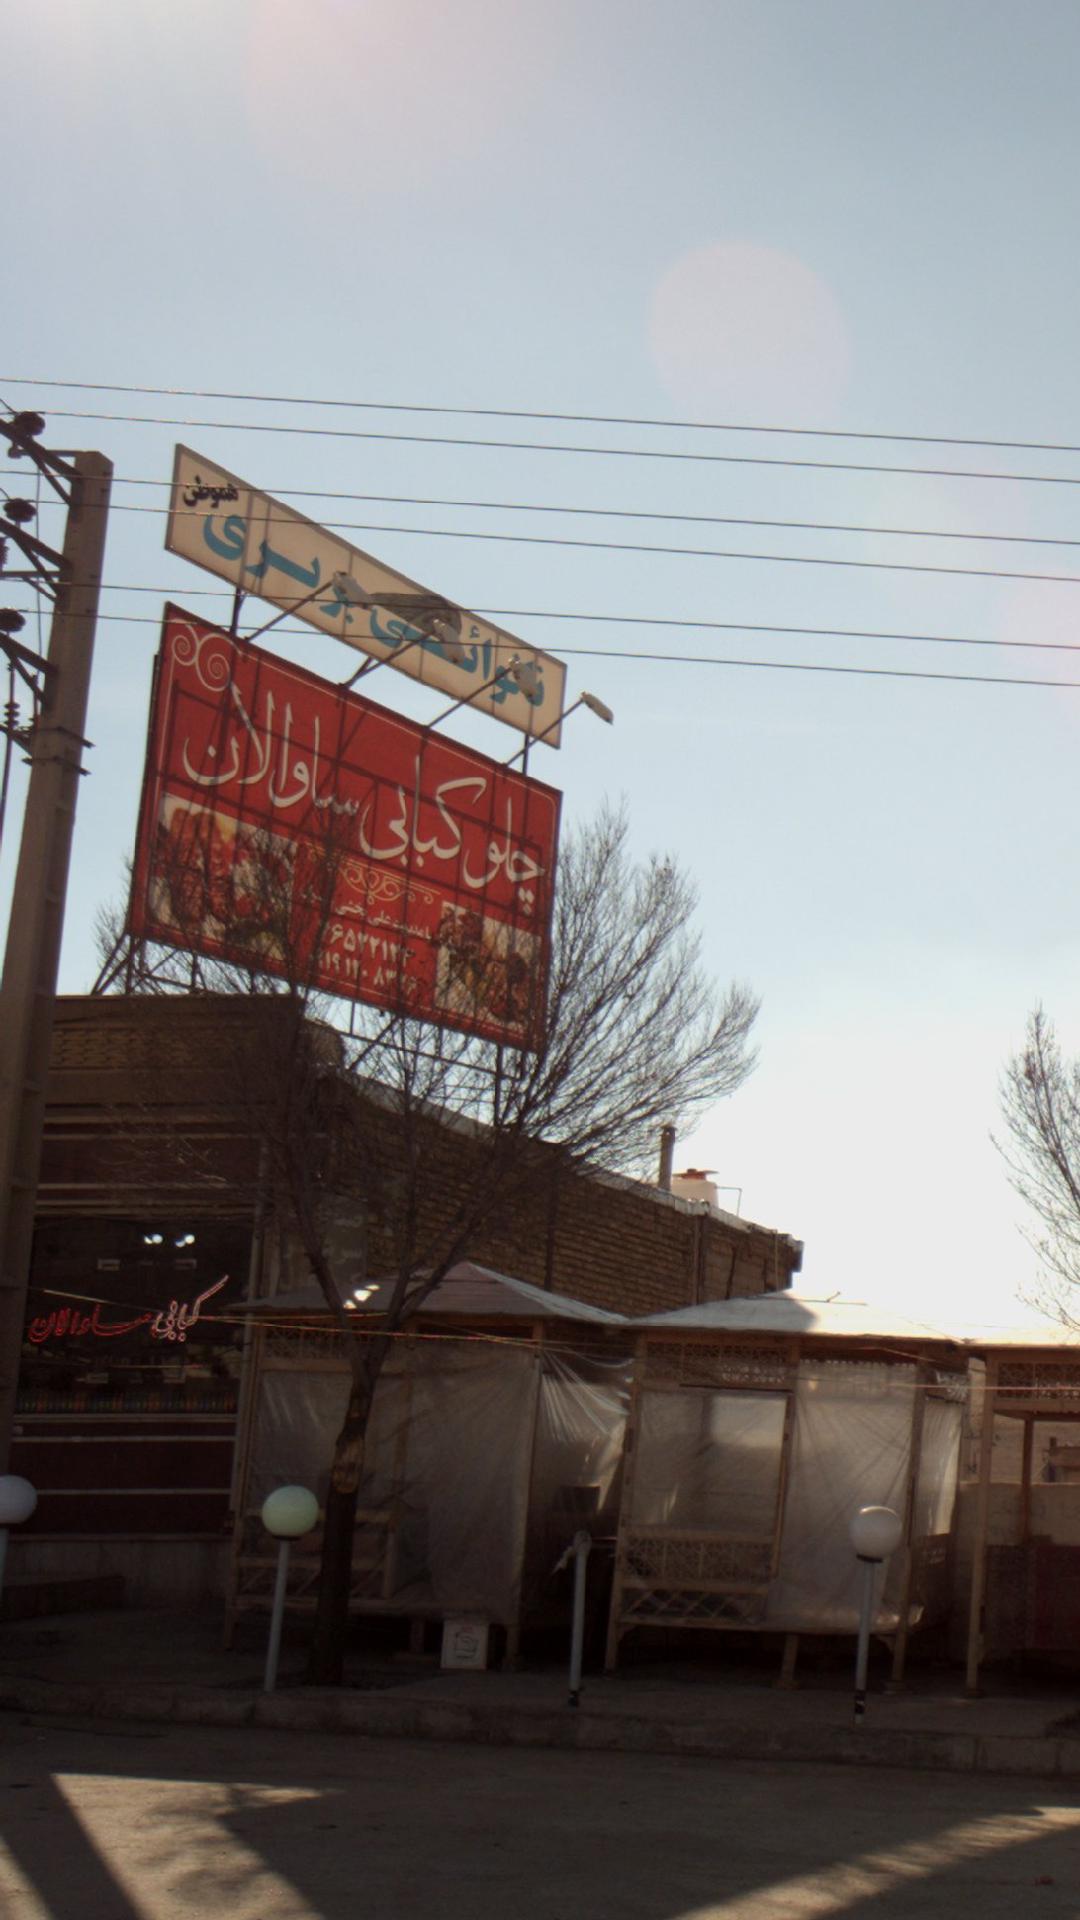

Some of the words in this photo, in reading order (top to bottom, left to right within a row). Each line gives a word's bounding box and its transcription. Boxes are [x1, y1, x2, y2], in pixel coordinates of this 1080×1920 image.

[183, 475, 239, 508] هموطن
[183, 682, 361, 816] ساوالان
[359, 755, 487, 868] کبابی
[463, 796, 545, 914] چلو
